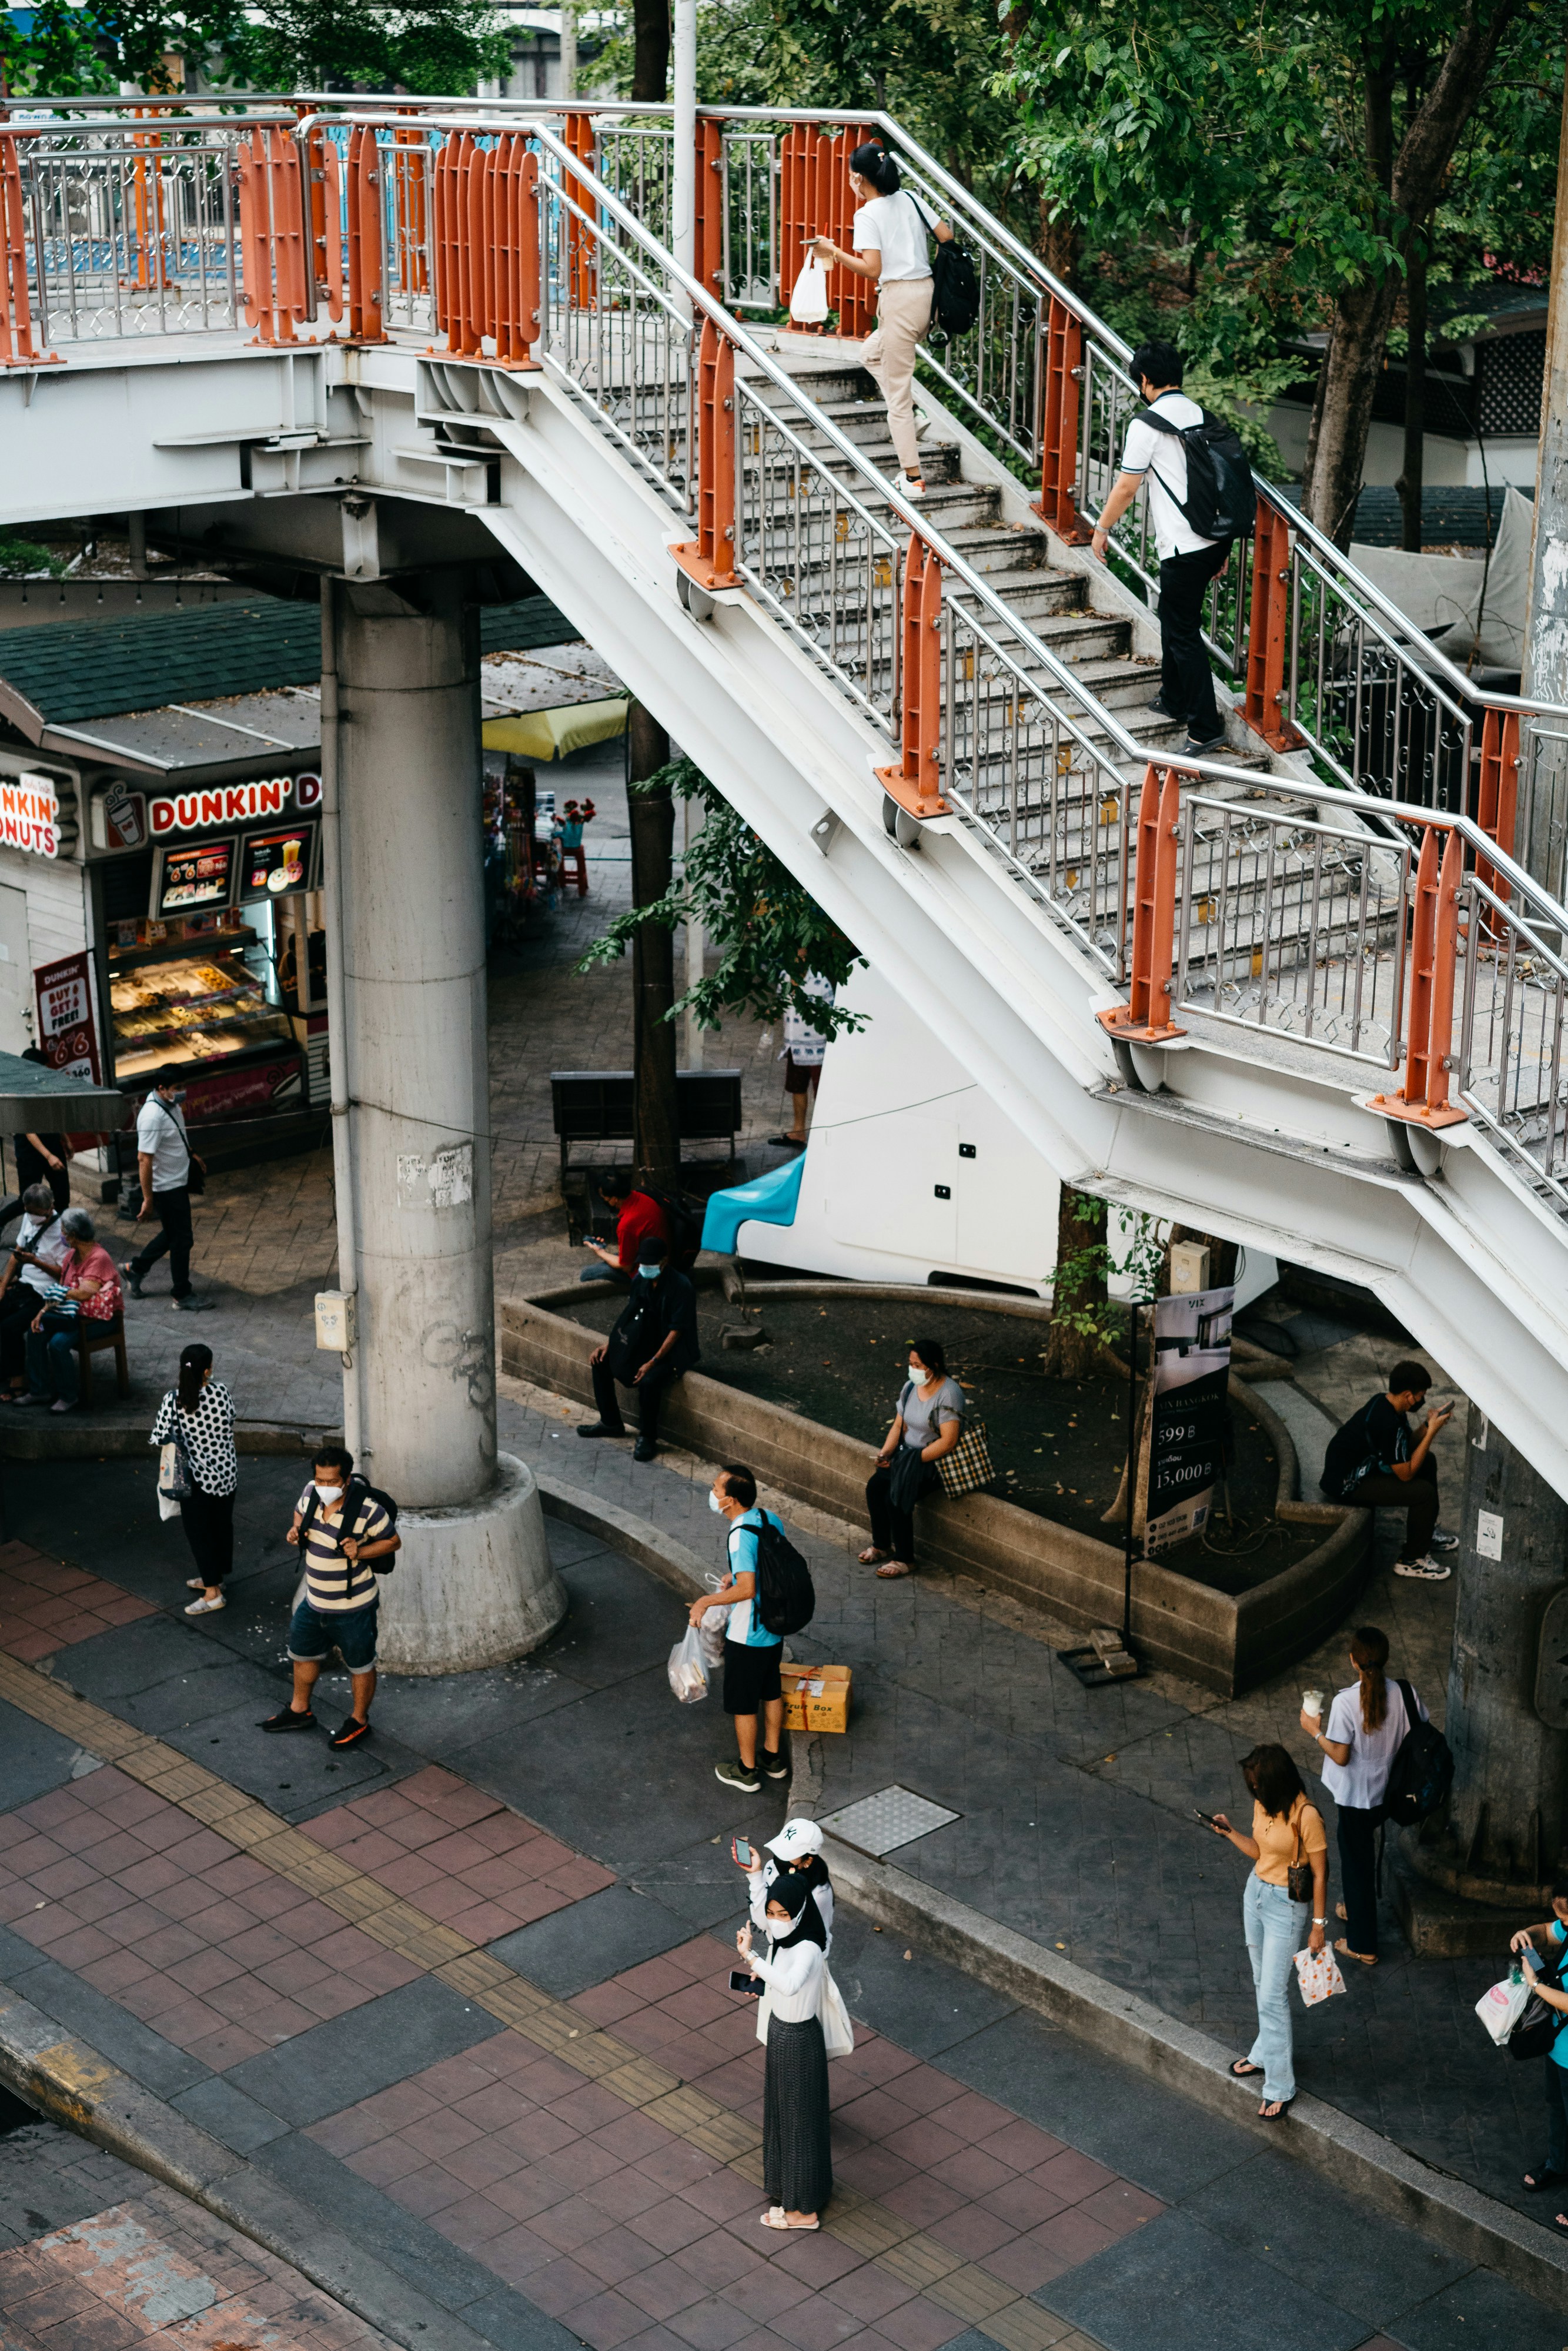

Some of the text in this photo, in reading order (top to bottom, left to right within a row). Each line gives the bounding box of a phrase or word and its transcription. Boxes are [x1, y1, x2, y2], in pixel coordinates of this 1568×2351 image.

[153, 781, 290, 831] DUNKIN'
[49, 986, 70, 1004] BUY
[51, 999, 71, 1016] GET
[52, 1009, 79, 1030] FREE!
[1189, 1298, 1205, 1309] VIX
[1158, 1426, 1185, 1446] 599
[1156, 1464, 1202, 1489] 15,000
